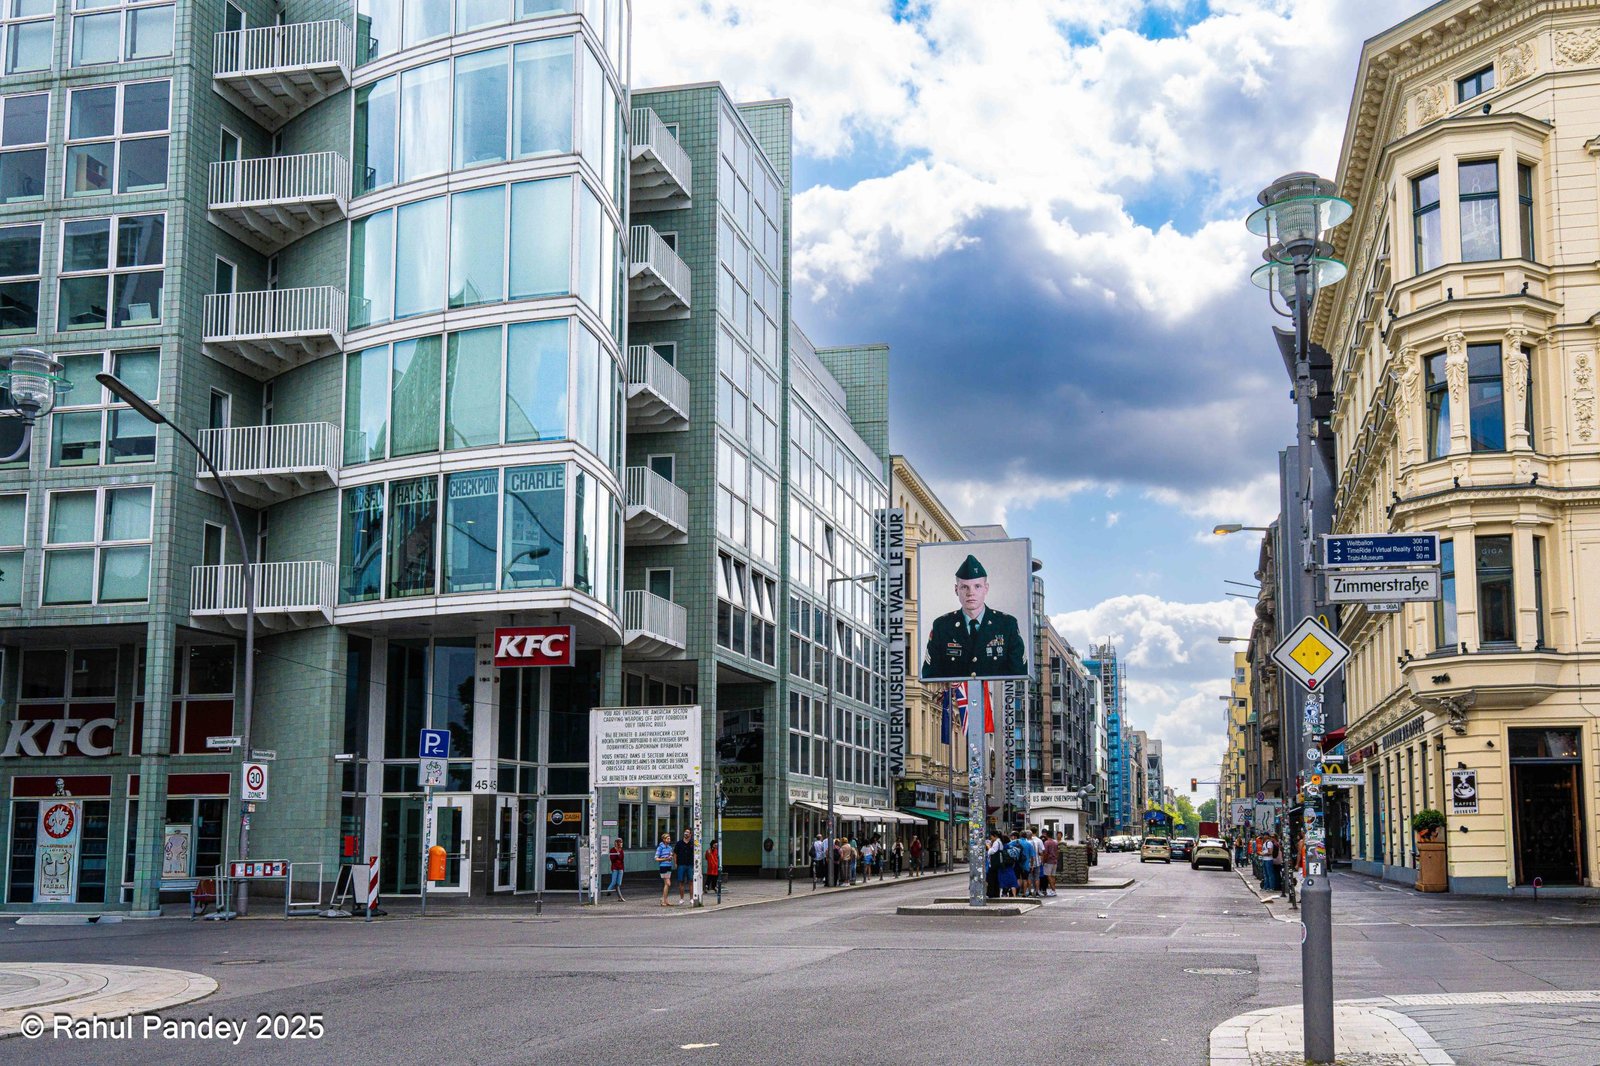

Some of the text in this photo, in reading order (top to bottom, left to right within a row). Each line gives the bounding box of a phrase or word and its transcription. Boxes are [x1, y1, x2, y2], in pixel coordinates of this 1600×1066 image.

[350, 488, 384, 511] MUSEU
[397, 484, 424, 504] HAUS
[449, 477, 498, 497] CHECKPOIN
[511, 471, 563, 491] CHARLIE
[1333, 576, 1429, 594] Zimmerstraße
[495, 634, 564, 658] KFC
[890, 513, 903, 771] MAUERMUSEUM THE WALL LE MUR
[0, 718, 118, 757] KFC
[250, 772, 260, 784] 30
[475, 780, 488, 790] 45
[489, 780, 497, 790] 45
